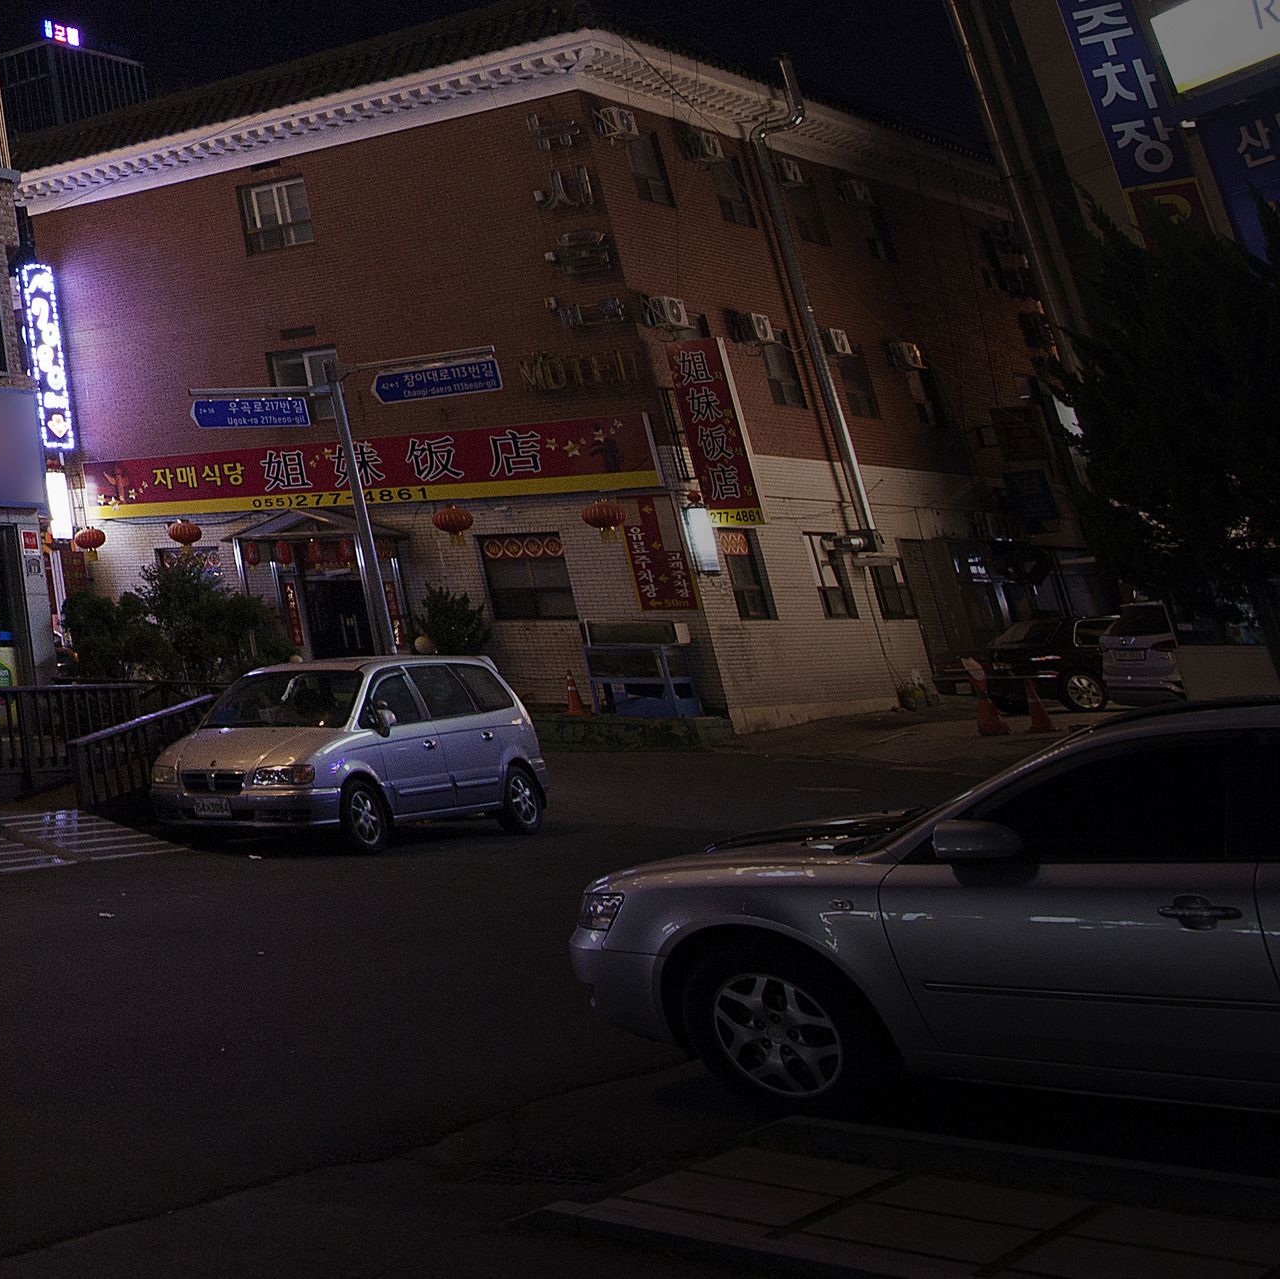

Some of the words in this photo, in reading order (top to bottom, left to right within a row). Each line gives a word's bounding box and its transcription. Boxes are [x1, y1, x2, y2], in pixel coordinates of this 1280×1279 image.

[227, 416, 259, 426] Ugok-ro
[228, 401, 304, 415] 우곡로217번길
[680, 350, 741, 501] 姐妹饭店
[151, 461, 246, 490] 자매식당
[260, 429, 542, 493] 姐妹饭店
[709, 508, 761, 524] 277-4861
[627, 526, 658, 598] 유료주차장
